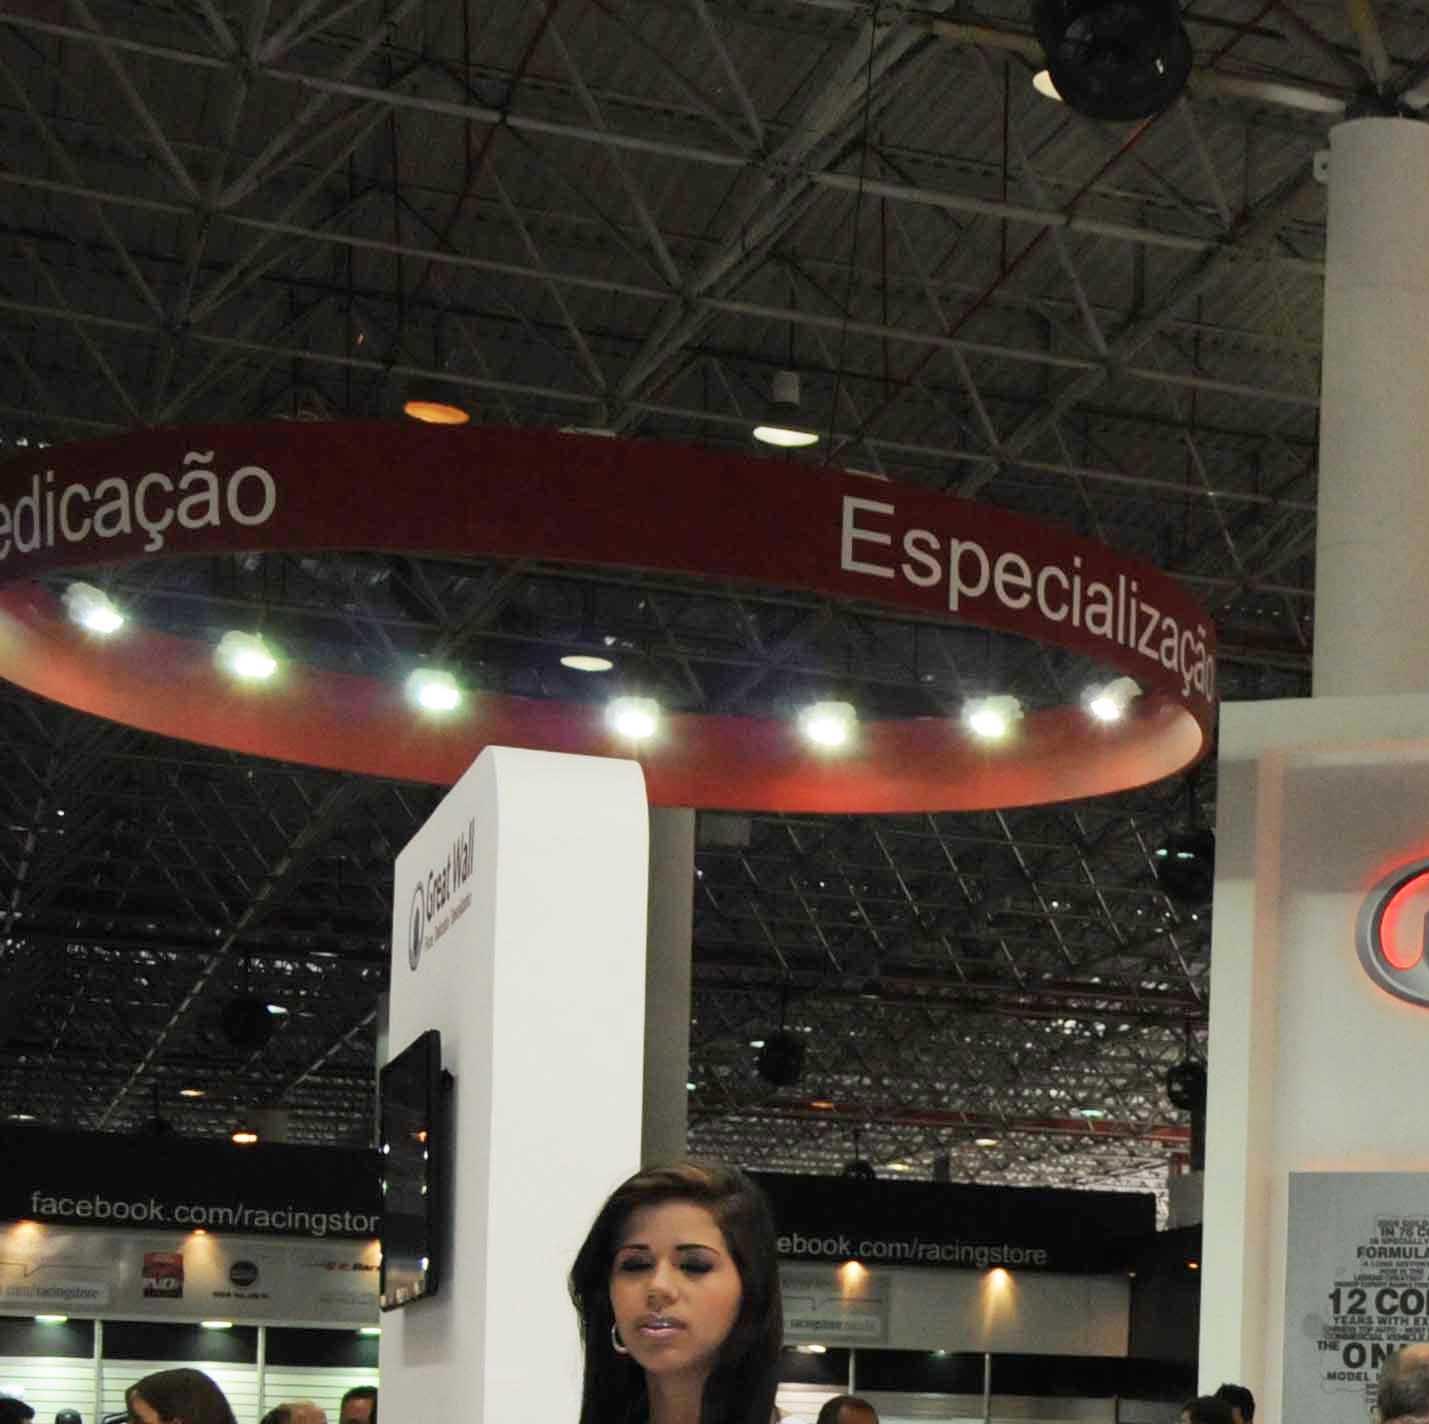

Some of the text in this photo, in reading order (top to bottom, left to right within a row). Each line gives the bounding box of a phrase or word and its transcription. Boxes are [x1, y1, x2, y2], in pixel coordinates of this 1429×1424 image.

[841, 495, 1217, 703] Especialização
[1328, 1288, 1367, 1316] 12
[1334, 1316, 1374, 1326] YEARS
[1378, 1316, 1410, 1327] WITH
[1317, 1340, 1340, 1351] THE
[1342, 1342, 1409, 1370] ON
[1326, 1371, 1370, 1381] MODEL
